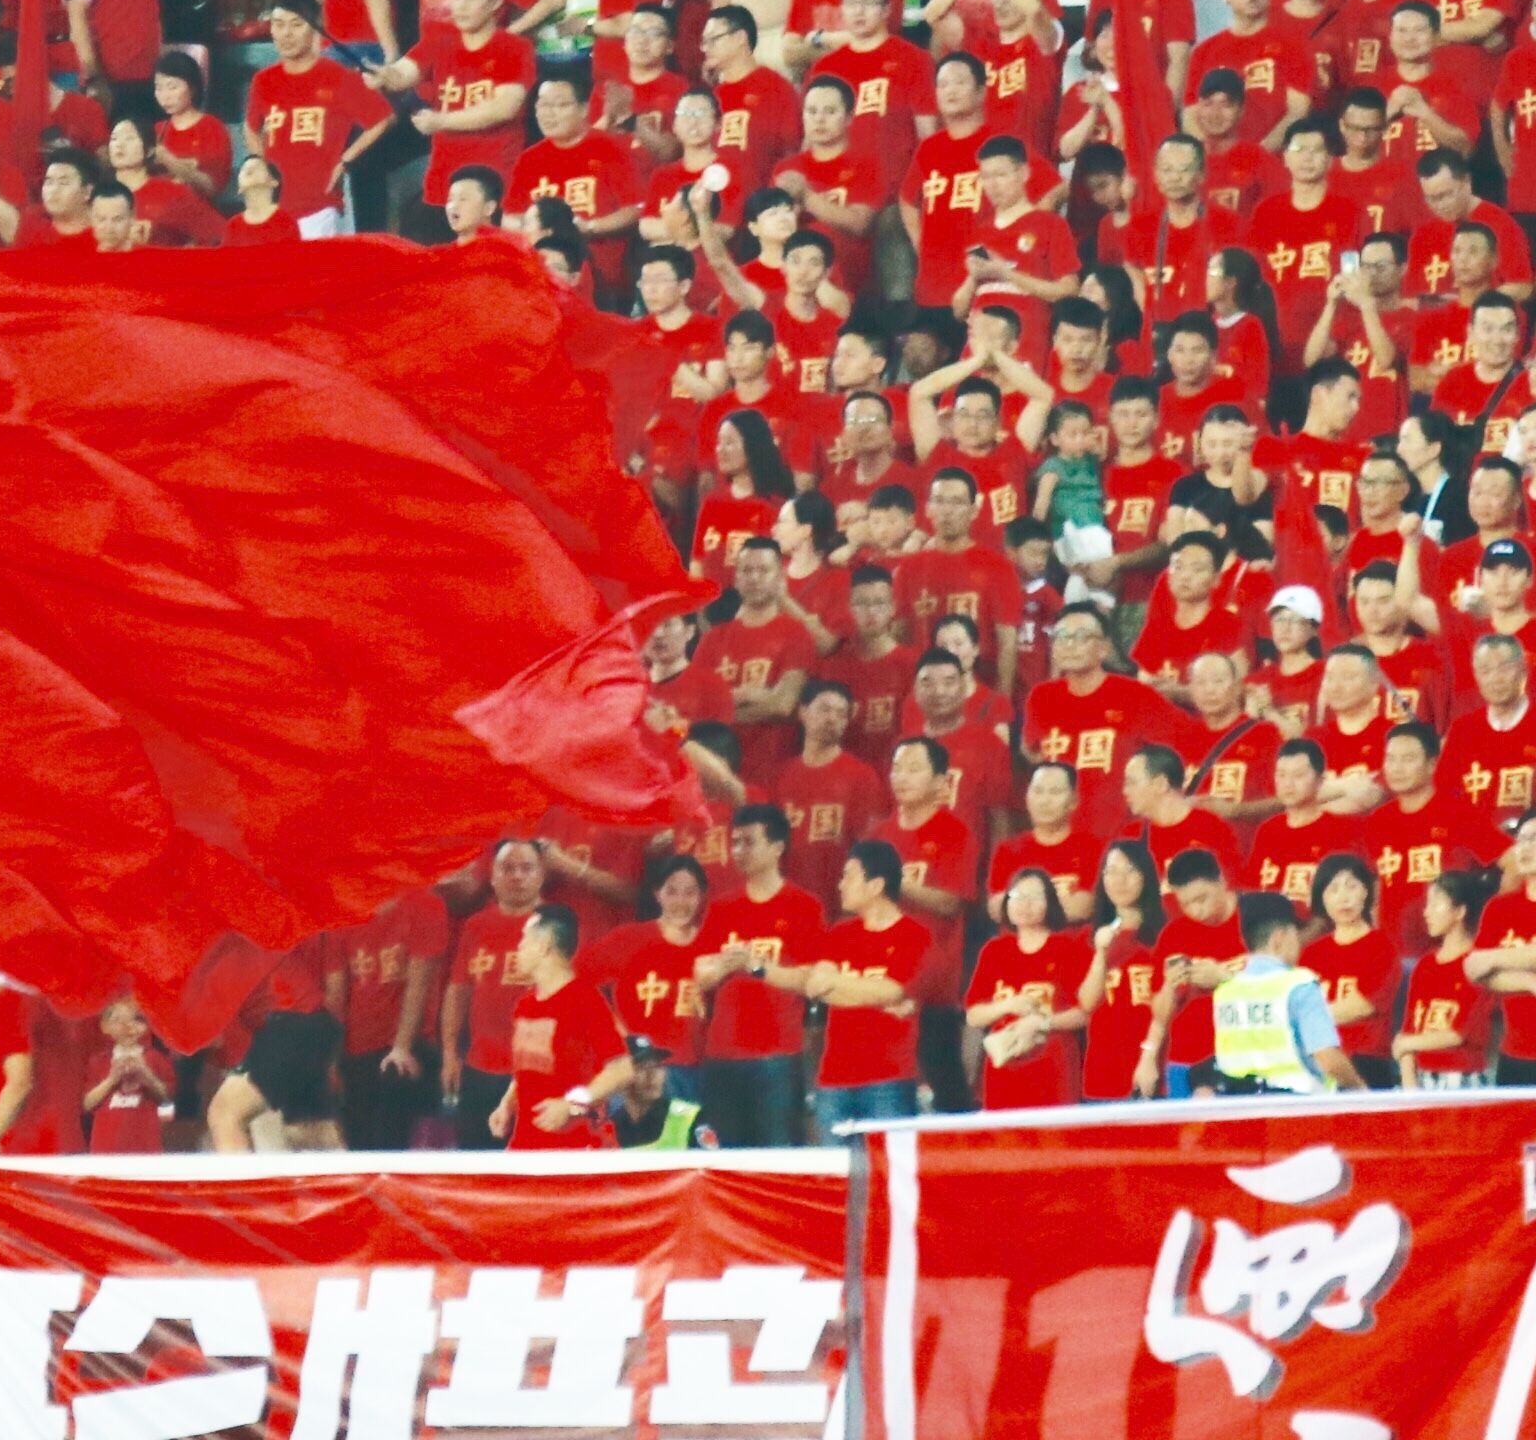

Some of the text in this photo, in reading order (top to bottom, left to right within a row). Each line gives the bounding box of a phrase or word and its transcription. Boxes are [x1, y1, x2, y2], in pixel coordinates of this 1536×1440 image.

[264, 105, 323, 146] 中国
[924, 170, 985, 212] 中国
[1268, 242, 1330, 281] 中国
[1043, 728, 1113, 776] 中国
[1464, 762, 1534, 809] 中国
[1375, 844, 1441, 892] 中国
